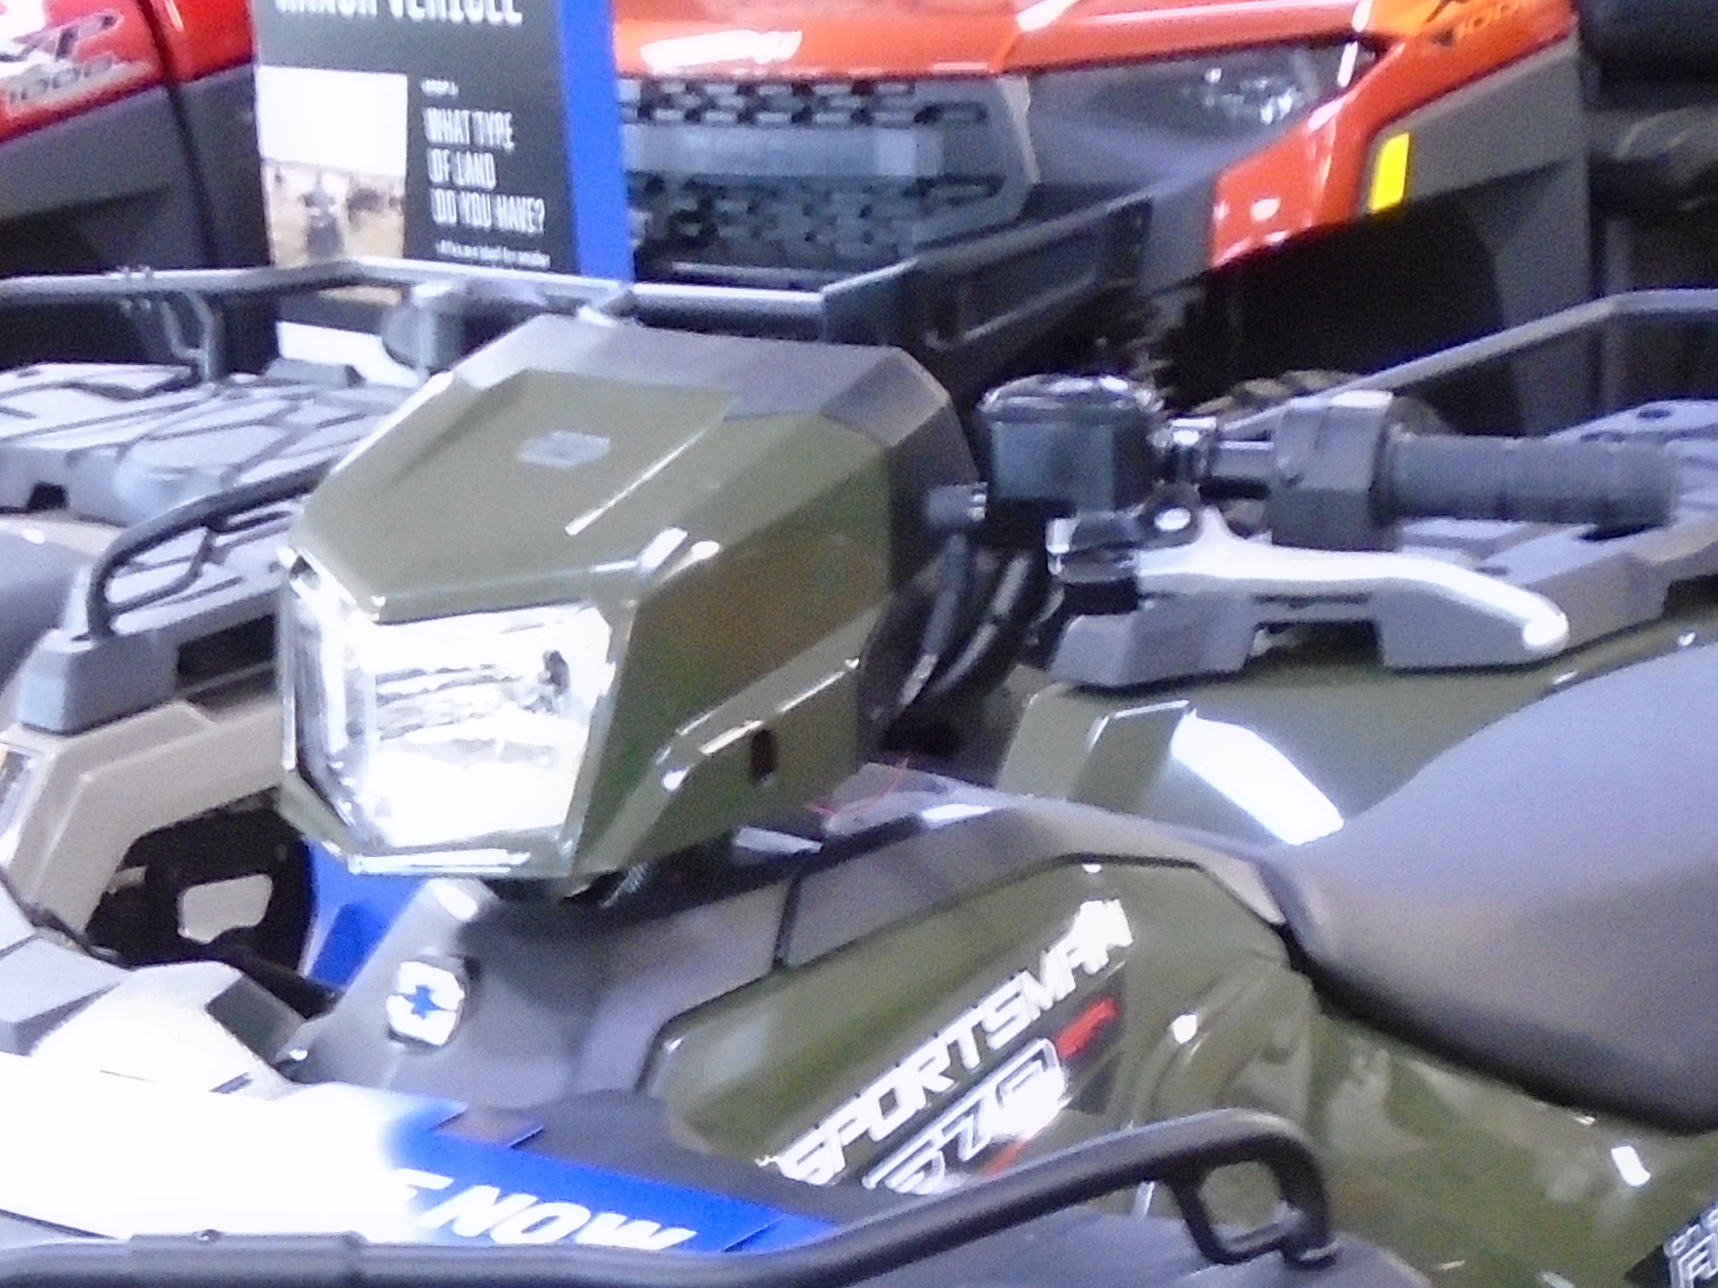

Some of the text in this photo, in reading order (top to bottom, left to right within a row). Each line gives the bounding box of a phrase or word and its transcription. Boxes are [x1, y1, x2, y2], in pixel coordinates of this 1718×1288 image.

[423, 106, 515, 151] WHAT TYPE
[427, 147, 497, 189] OF LAND
[431, 187, 546, 235] DO YOU HAVE?
[755, 898, 1134, 1186] SPORTSMAN
[415, 1184, 699, 1251] NOW
